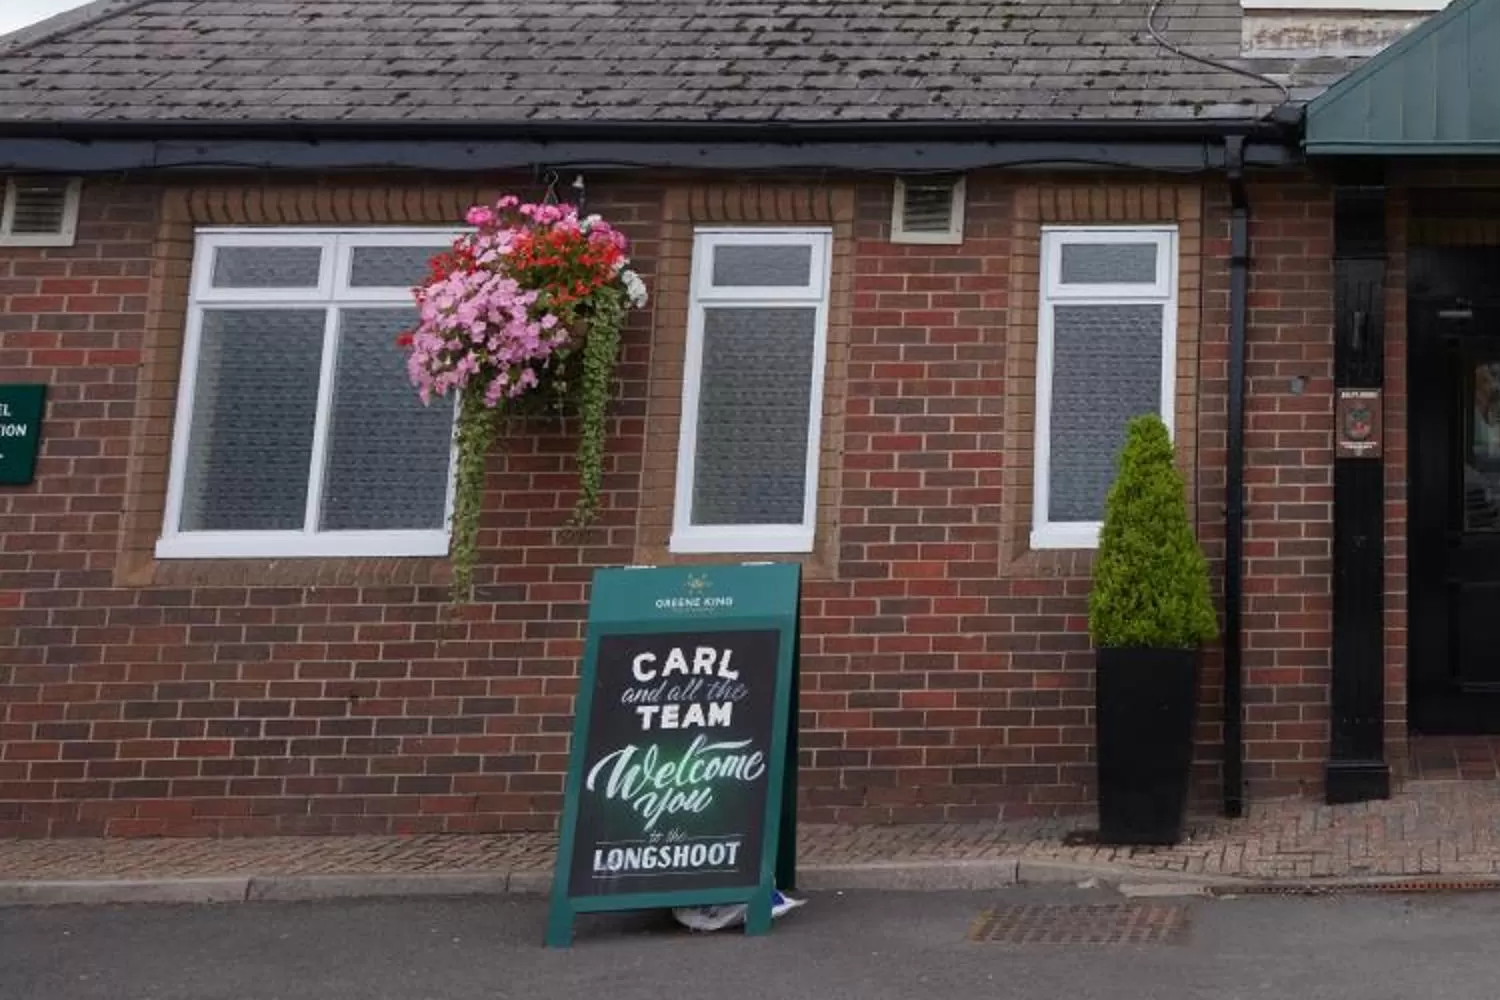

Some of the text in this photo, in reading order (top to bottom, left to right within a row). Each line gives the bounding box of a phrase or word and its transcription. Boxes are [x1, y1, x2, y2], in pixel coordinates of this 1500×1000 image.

[632, 646, 740, 682] CARL
[621, 678, 749, 704] and all the
[635, 701, 733, 731] TEAM
[586, 733, 766, 800] Welcome
[593, 841, 741, 872] LONGSHOOT
